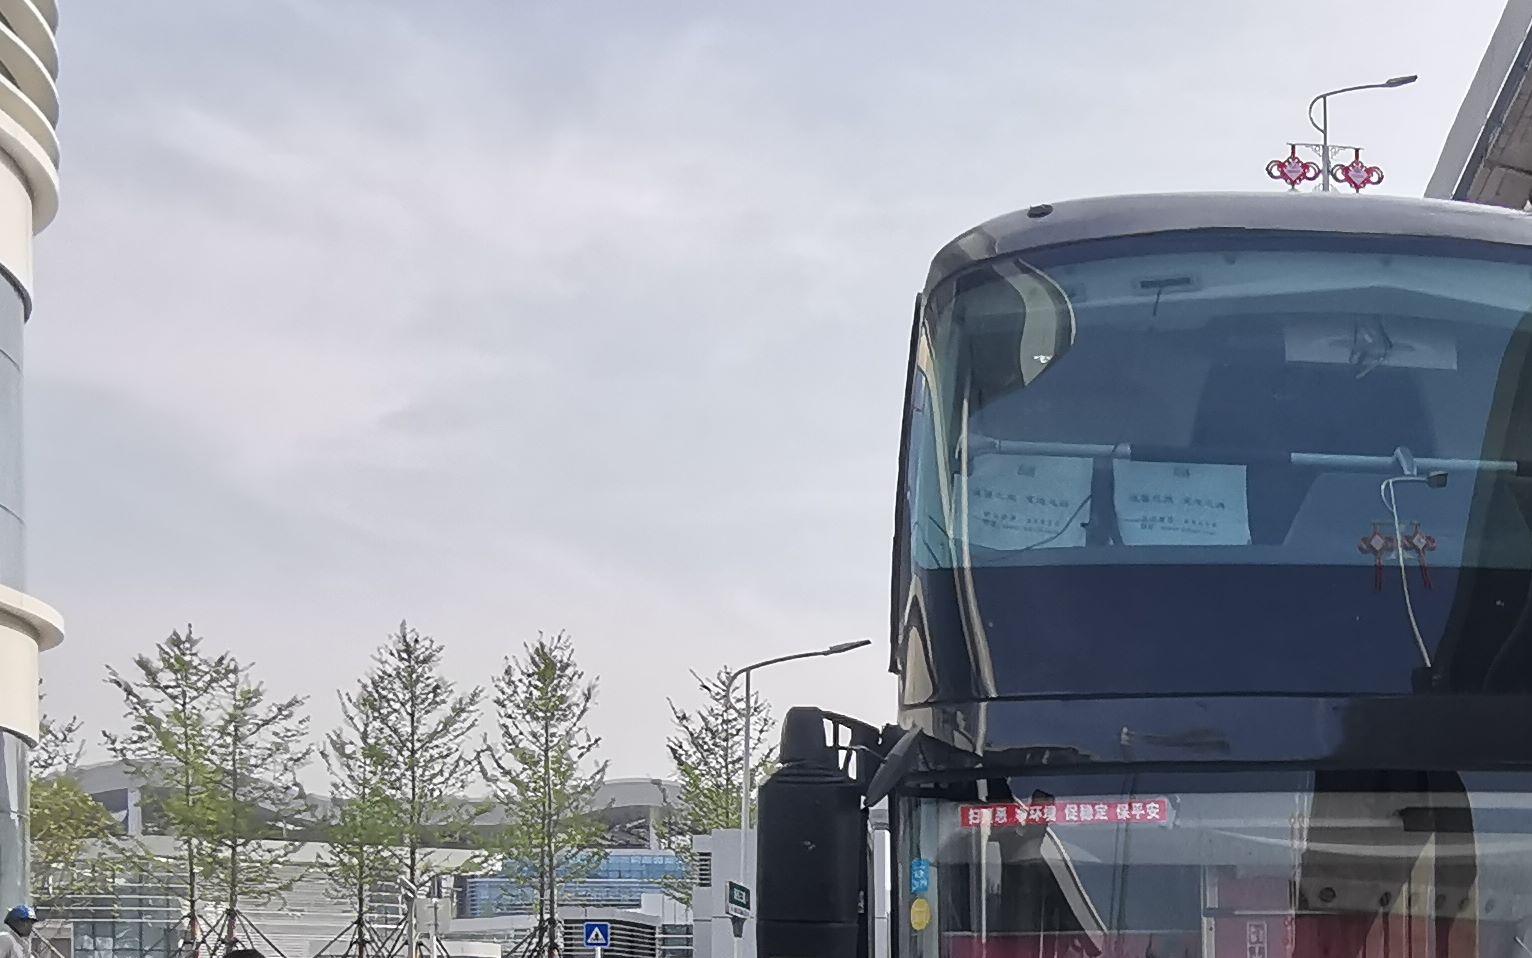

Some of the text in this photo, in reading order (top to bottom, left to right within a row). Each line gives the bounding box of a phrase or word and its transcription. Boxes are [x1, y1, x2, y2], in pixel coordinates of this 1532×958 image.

[968, 807, 1008, 825] 扫恶
[1116, 801, 1160, 821] 保平安
